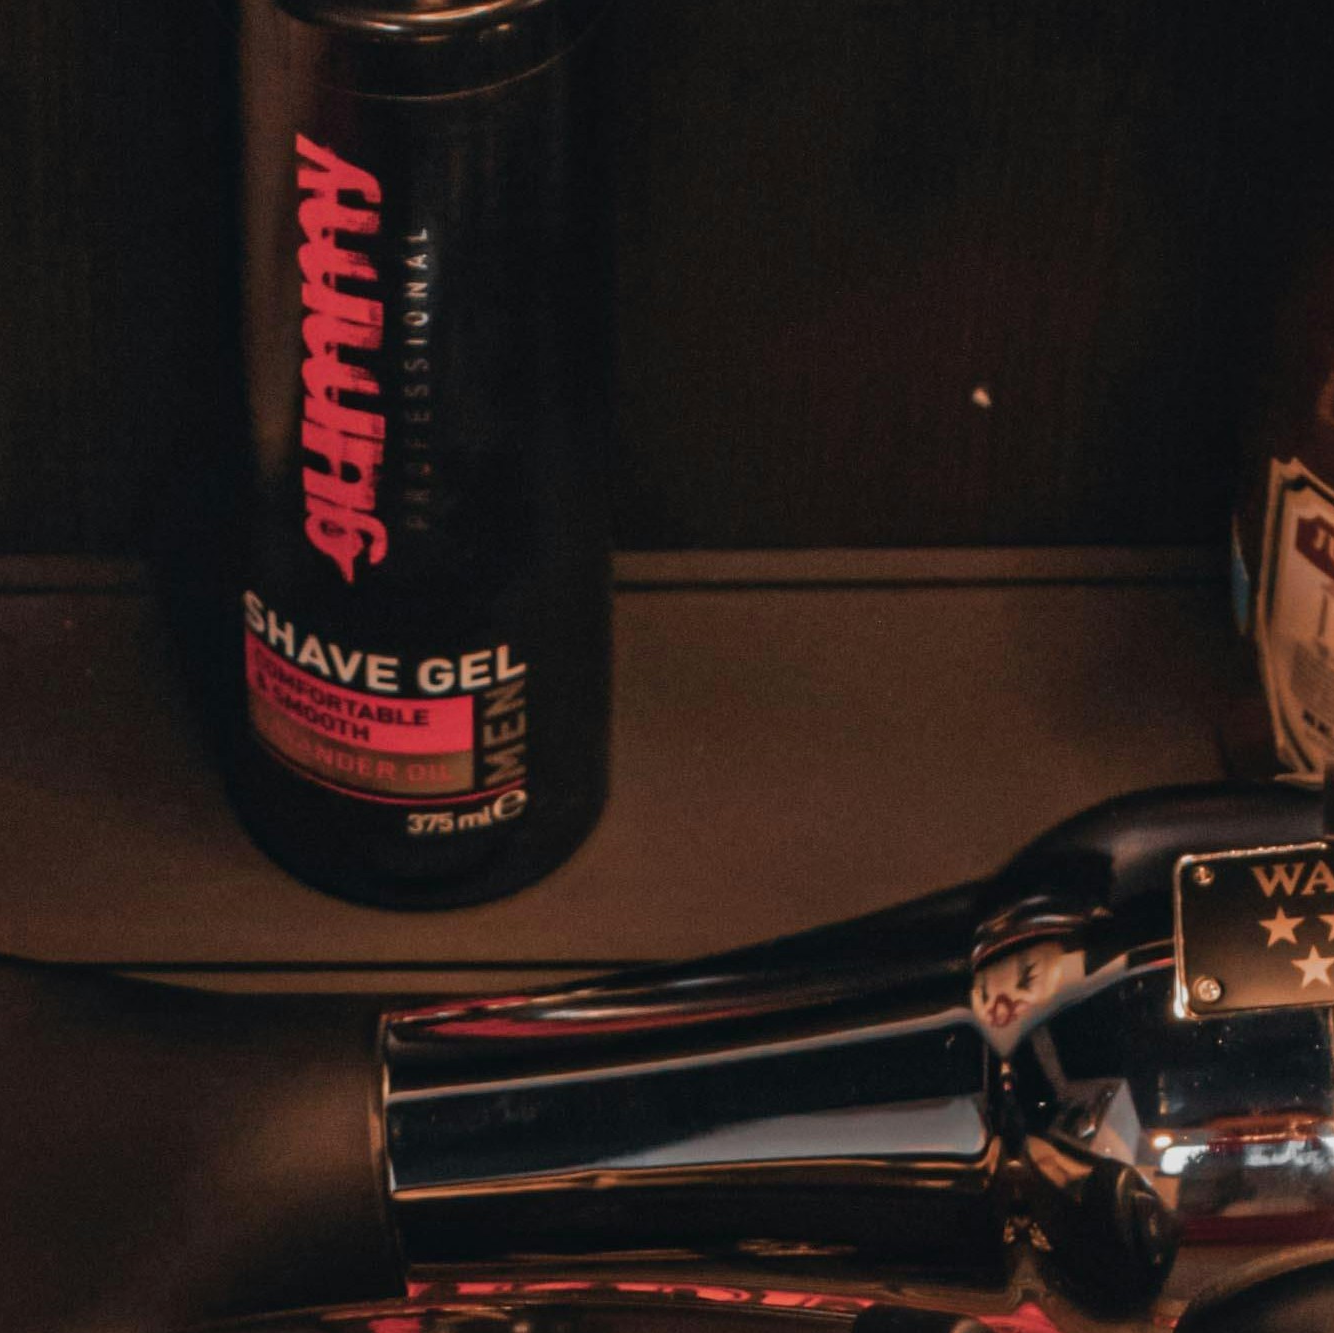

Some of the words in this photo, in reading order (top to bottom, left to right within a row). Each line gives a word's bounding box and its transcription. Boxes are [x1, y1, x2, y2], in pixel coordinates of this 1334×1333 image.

[295, 132, 388, 584] gummy
[242, 589, 400, 692] SHAVE
[418, 643, 528, 693] GEL
[482, 677, 527, 787] MEN
[407, 812, 454, 835] 375
